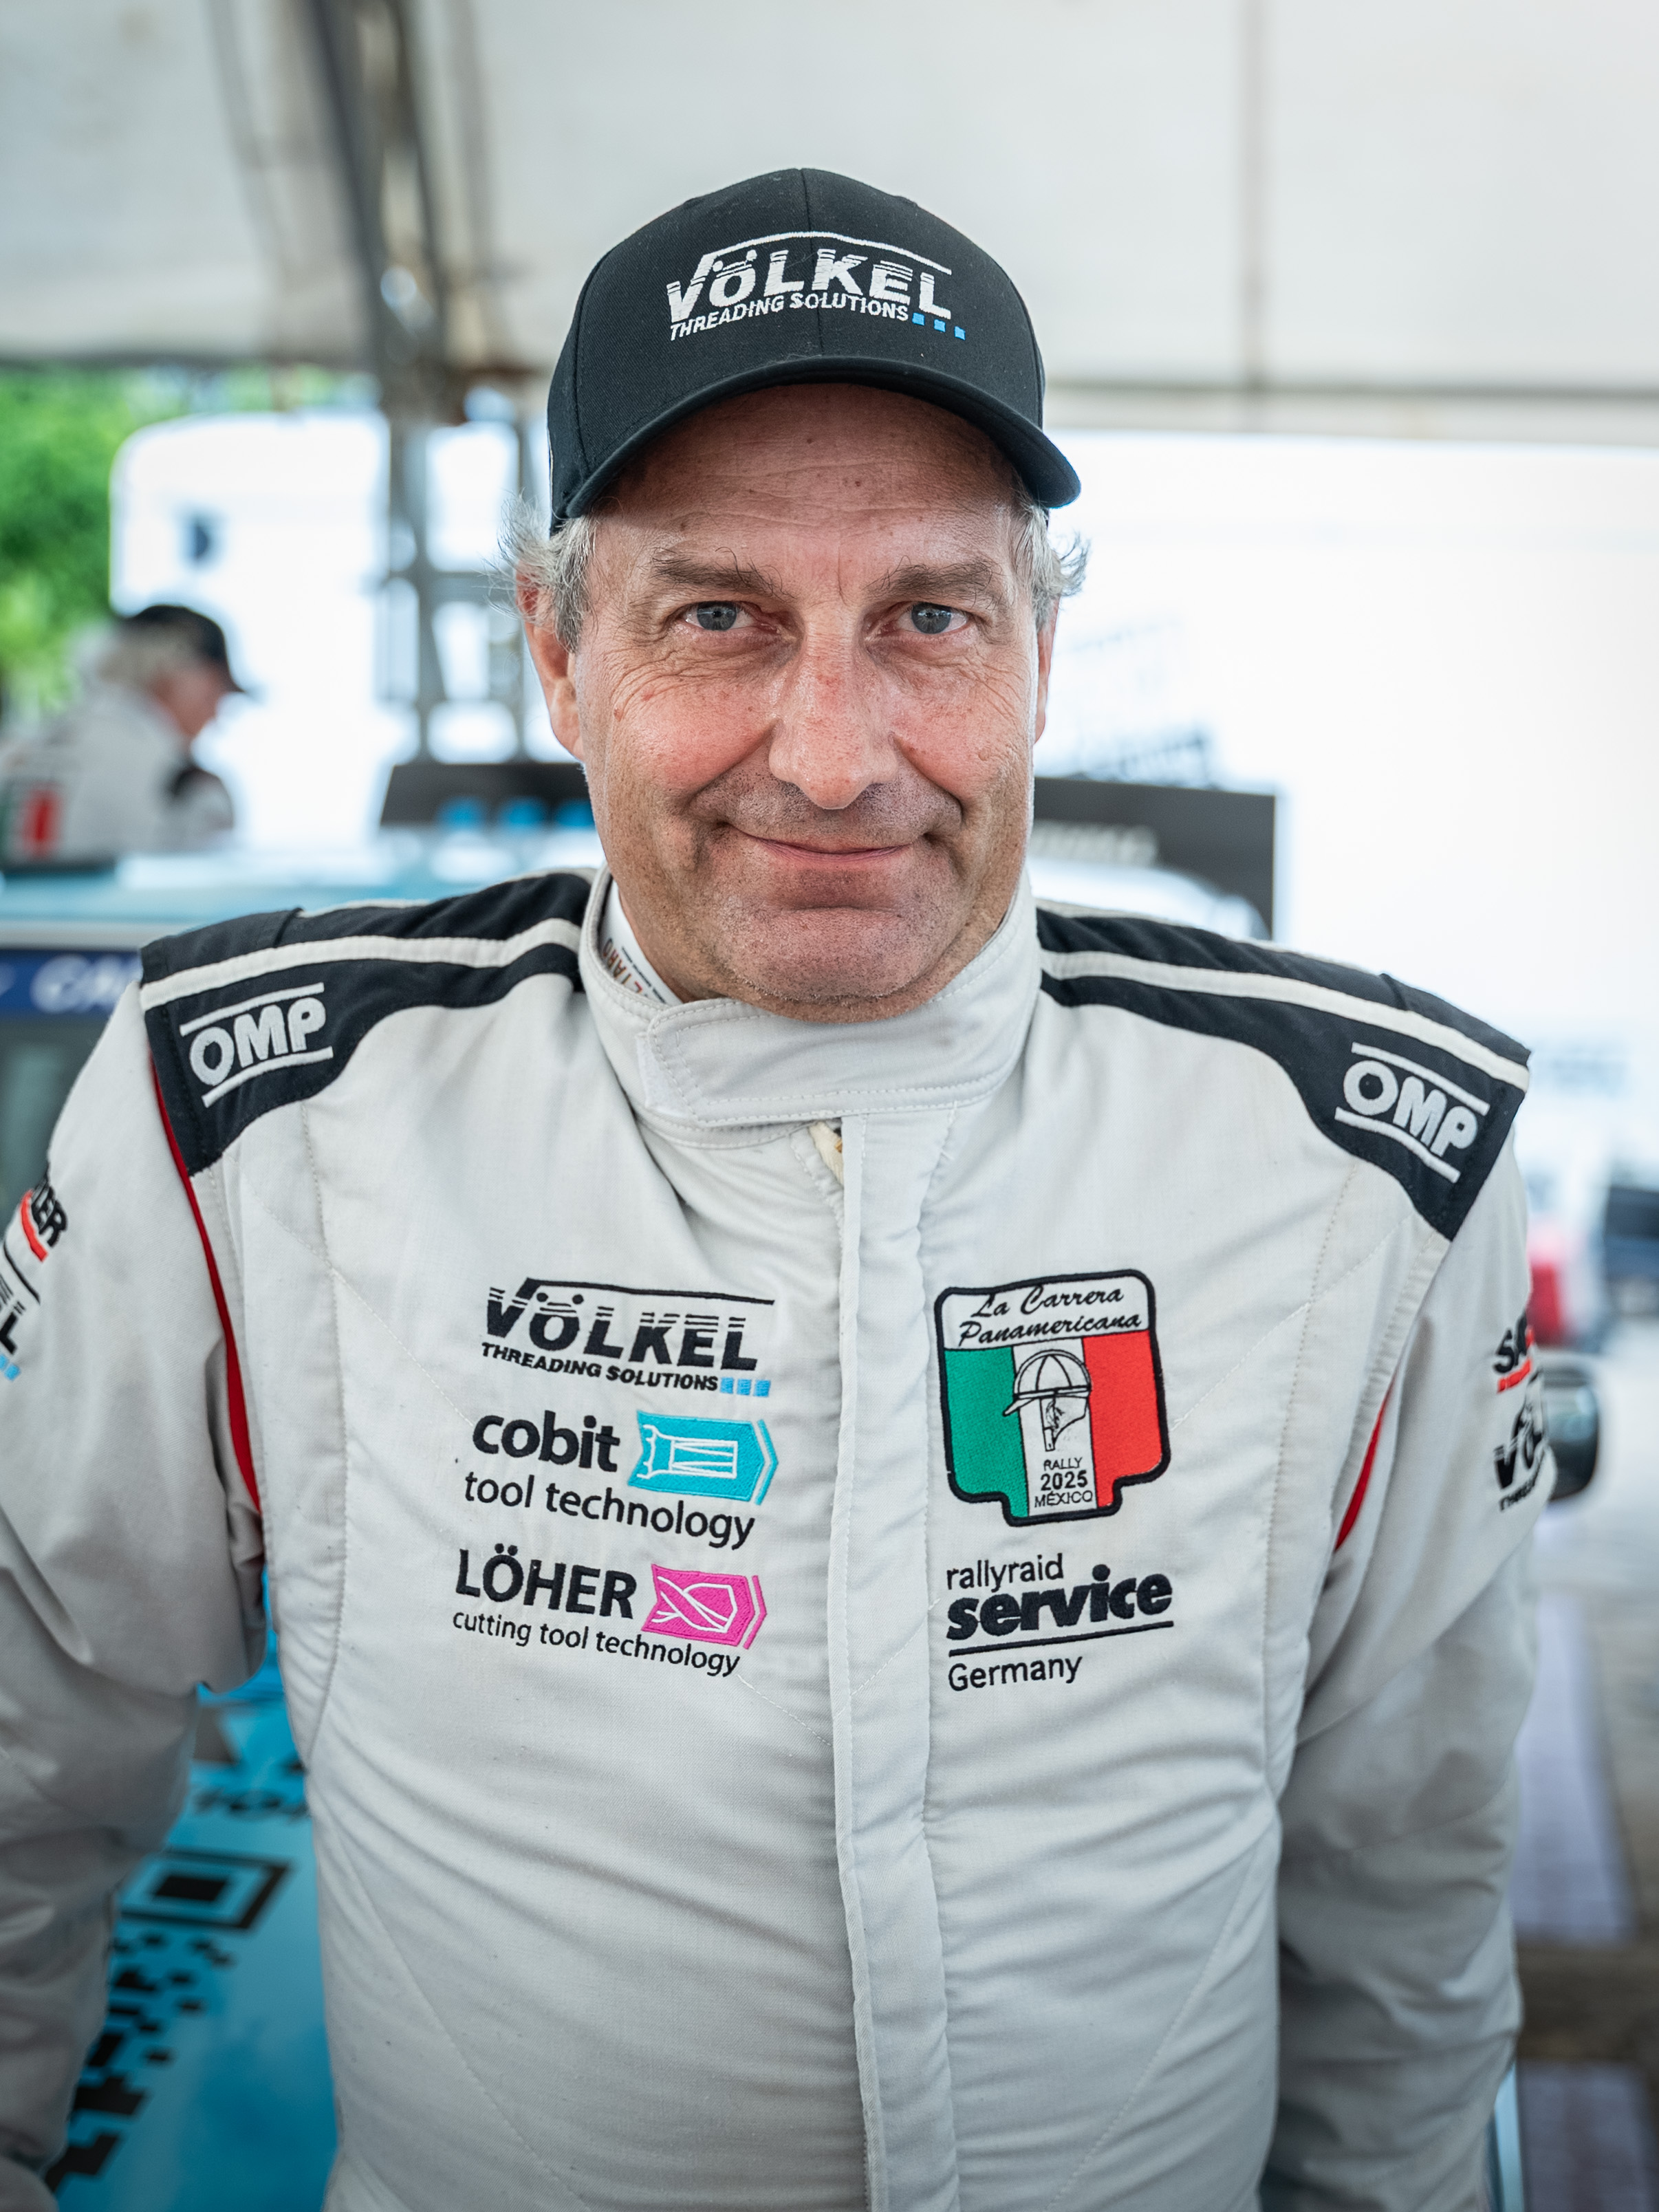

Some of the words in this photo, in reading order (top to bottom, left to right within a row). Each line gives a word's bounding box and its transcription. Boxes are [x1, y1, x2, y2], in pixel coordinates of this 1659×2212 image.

[666, 248, 951, 323] VÖLKEL
[671, 295, 785, 341] THREADING
[789, 292, 909, 322] SOLUTIONS
[190, 997, 326, 1086] OMP
[1343, 1060, 1478, 1157] OMP
[487, 1278, 758, 1371] VÖLKEL
[971, 1292, 1010, 1317] La
[1021, 1284, 1124, 1314] Carrera
[959, 1314, 1142, 1347] Panamericana
[481, 1343, 602, 1378] THREADING
[605, 1366, 718, 1391] SOLUTIONS
[473, 1409, 621, 1473] cobit
[1043, 1457, 1083, 1470] RALLY
[1034, 1490, 1093, 1508] MÉXICO
[1041, 1470, 1088, 1490] 2025
[465, 1471, 534, 1508] tool
[546, 1483, 755, 1550] technology
[456, 1543, 638, 1619] LÖHER
[946, 1552, 1064, 1592] rallyraid
[946, 1564, 1173, 1640] service
[453, 1610, 532, 1647] cutting
[540, 1623, 589, 1649] tool
[596, 1631, 741, 1677] technology
[948, 1656, 1083, 1691] Germany
